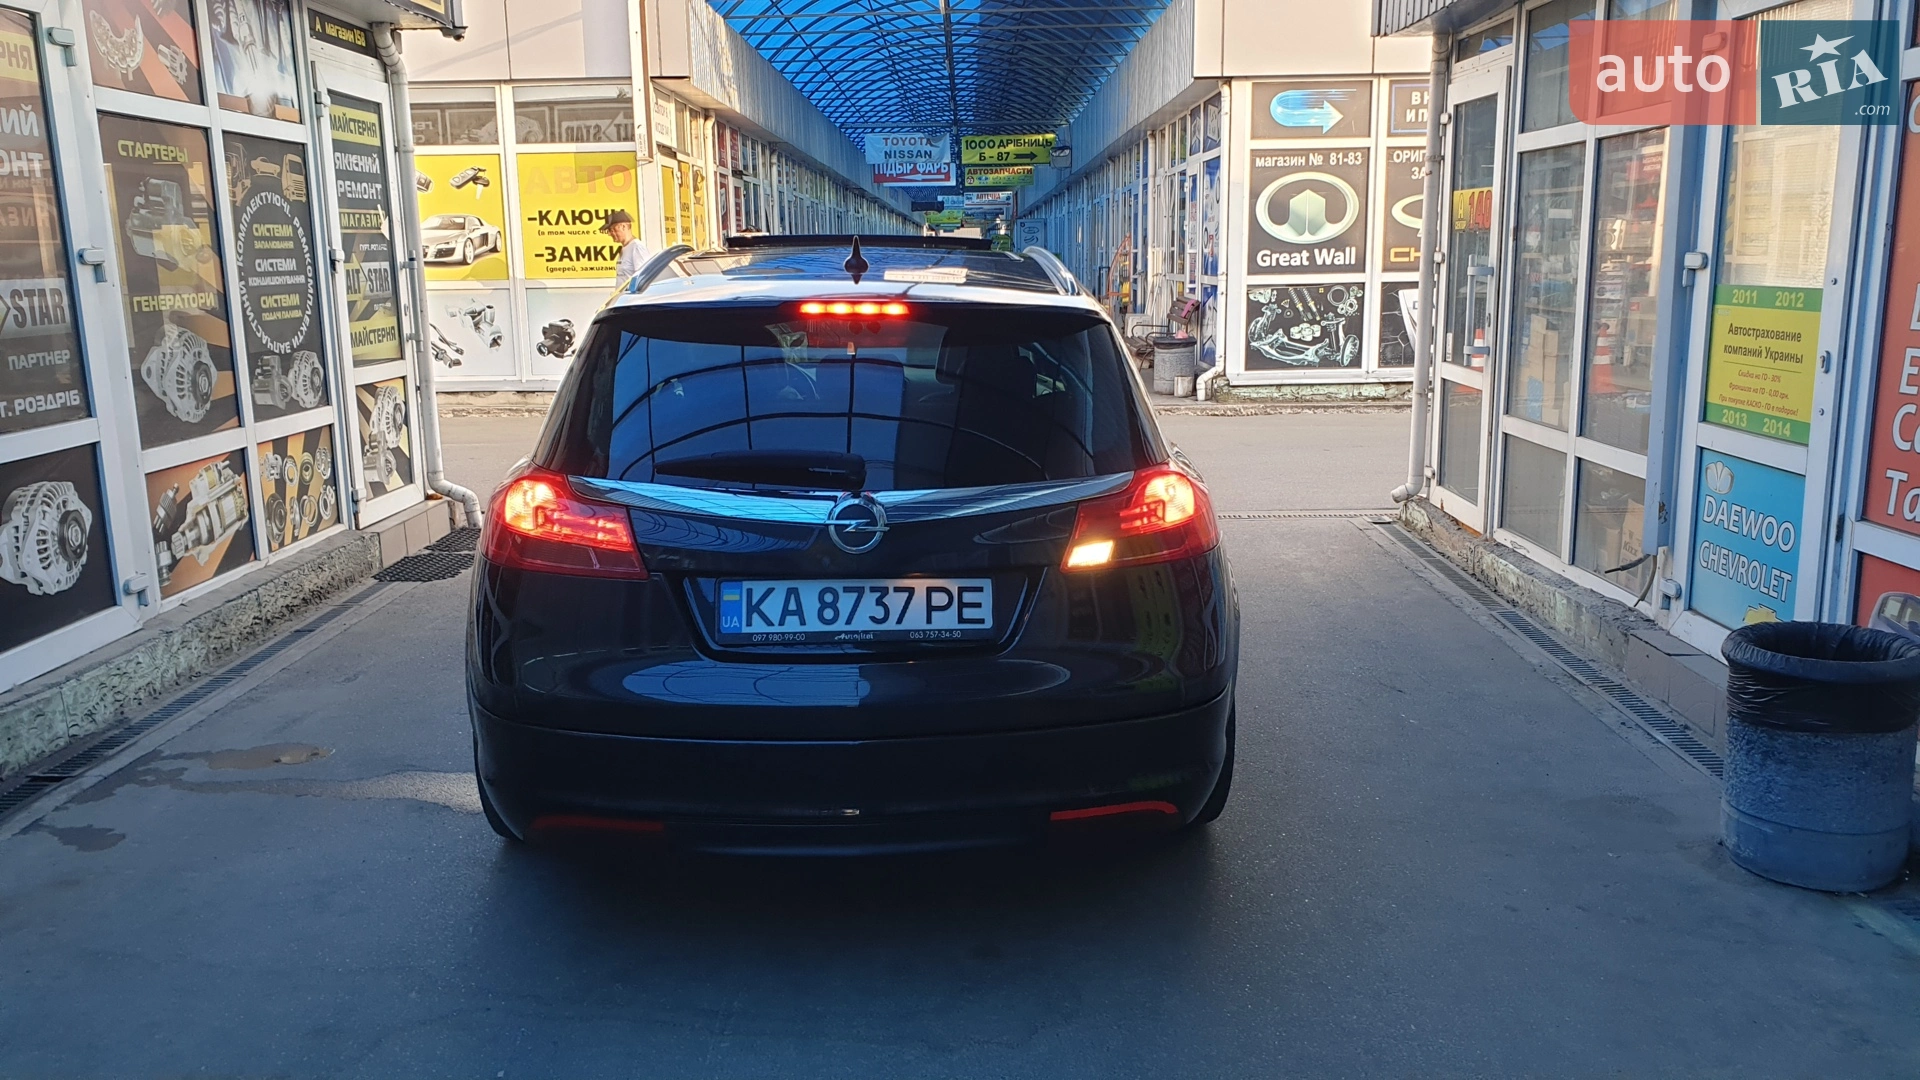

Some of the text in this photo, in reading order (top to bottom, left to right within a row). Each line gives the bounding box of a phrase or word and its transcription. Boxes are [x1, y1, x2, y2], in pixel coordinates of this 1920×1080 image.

[330, 112, 377, 138] МАЙСТЕРНЯ
[883, 136, 931, 146] TOYOTA
[965, 138, 1053, 150] 1000 ДРІБНИЦЬ
[117, 139, 188, 164] СТАРТЕРЫ
[884, 149, 932, 159] NISSAN
[997, 151, 1010, 161] 87
[1255, 155, 1305, 168] магазин
[1329, 151, 1362, 165] 81-83
[337, 180, 382, 199] РЕМОНТ
[252, 224, 293, 237] СИСТЕМИ
[255, 258, 297, 272] СИСТЕМИ
[1256, 247, 1356, 267] Great Wall
[346, 267, 390, 295] ALT STAR
[10, 288, 66, 328] STAR
[133, 291, 216, 313] ГЕНЕРАТОРИ
[260, 293, 300, 308] СИСТЕМИ
[1732, 289, 1804, 308] 2011 2012
[351, 326, 397, 348] МАЙСТЕРНЯ
[1728, 322, 1802, 342] Автострахование
[8, 349, 70, 370] ПАРТНЕР
[1723, 344, 1803, 364] компаний Украины
[14, 389, 80, 415] РОЗДРІБ
[1722, 409, 1791, 437] 2013 2014
[1702, 494, 1795, 552] DAEWOO
[1699, 540, 1792, 602] CHEVROLET
[745, 585, 985, 627] KA 8737 PE
[722, 616, 740, 628] UA
[769, 633, 805, 641] 980-99-00
[910, 630, 961, 639] 063 757-34-50
